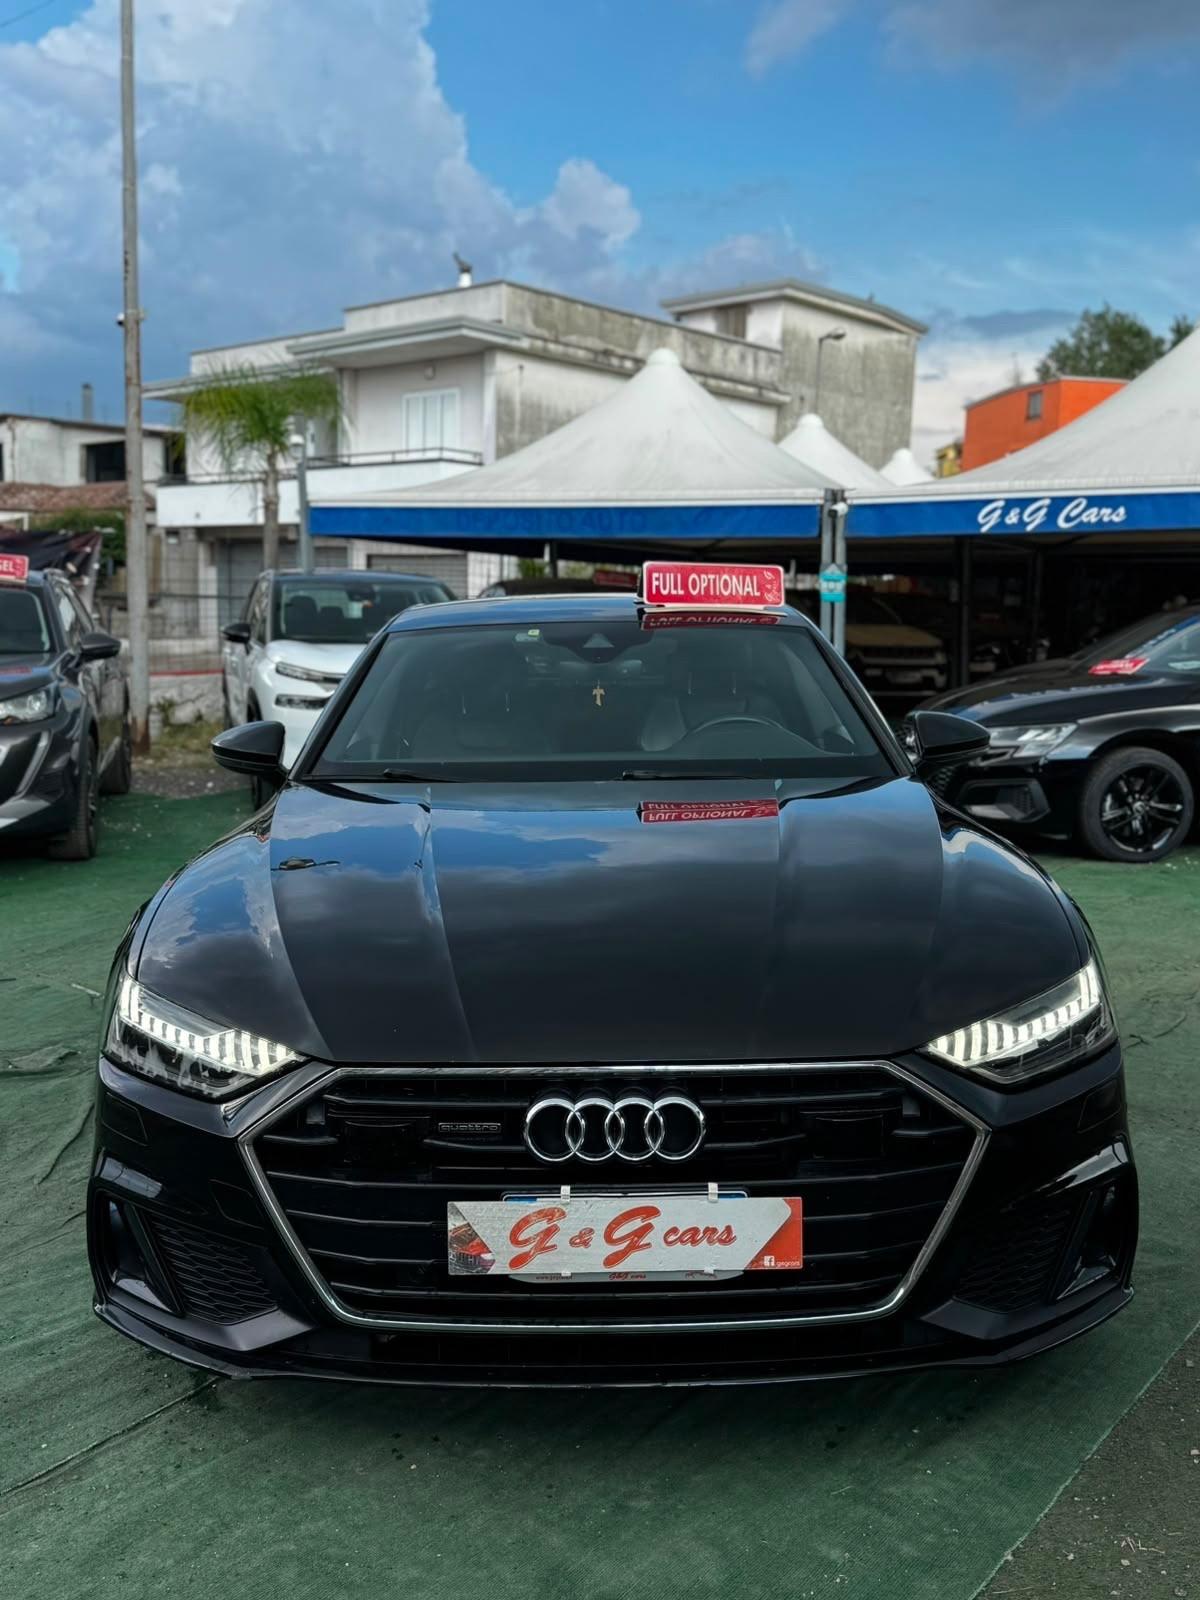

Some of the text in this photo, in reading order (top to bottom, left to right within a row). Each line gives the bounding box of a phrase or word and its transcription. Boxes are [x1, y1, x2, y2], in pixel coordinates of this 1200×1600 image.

[1056, 497, 1128, 529] Cars
[652, 573, 686, 596] FULL
[687, 573, 761, 597] OPTIONAL
[440, 1124, 499, 1132] quattro
[508, 1205, 738, 1271] G & G cars
